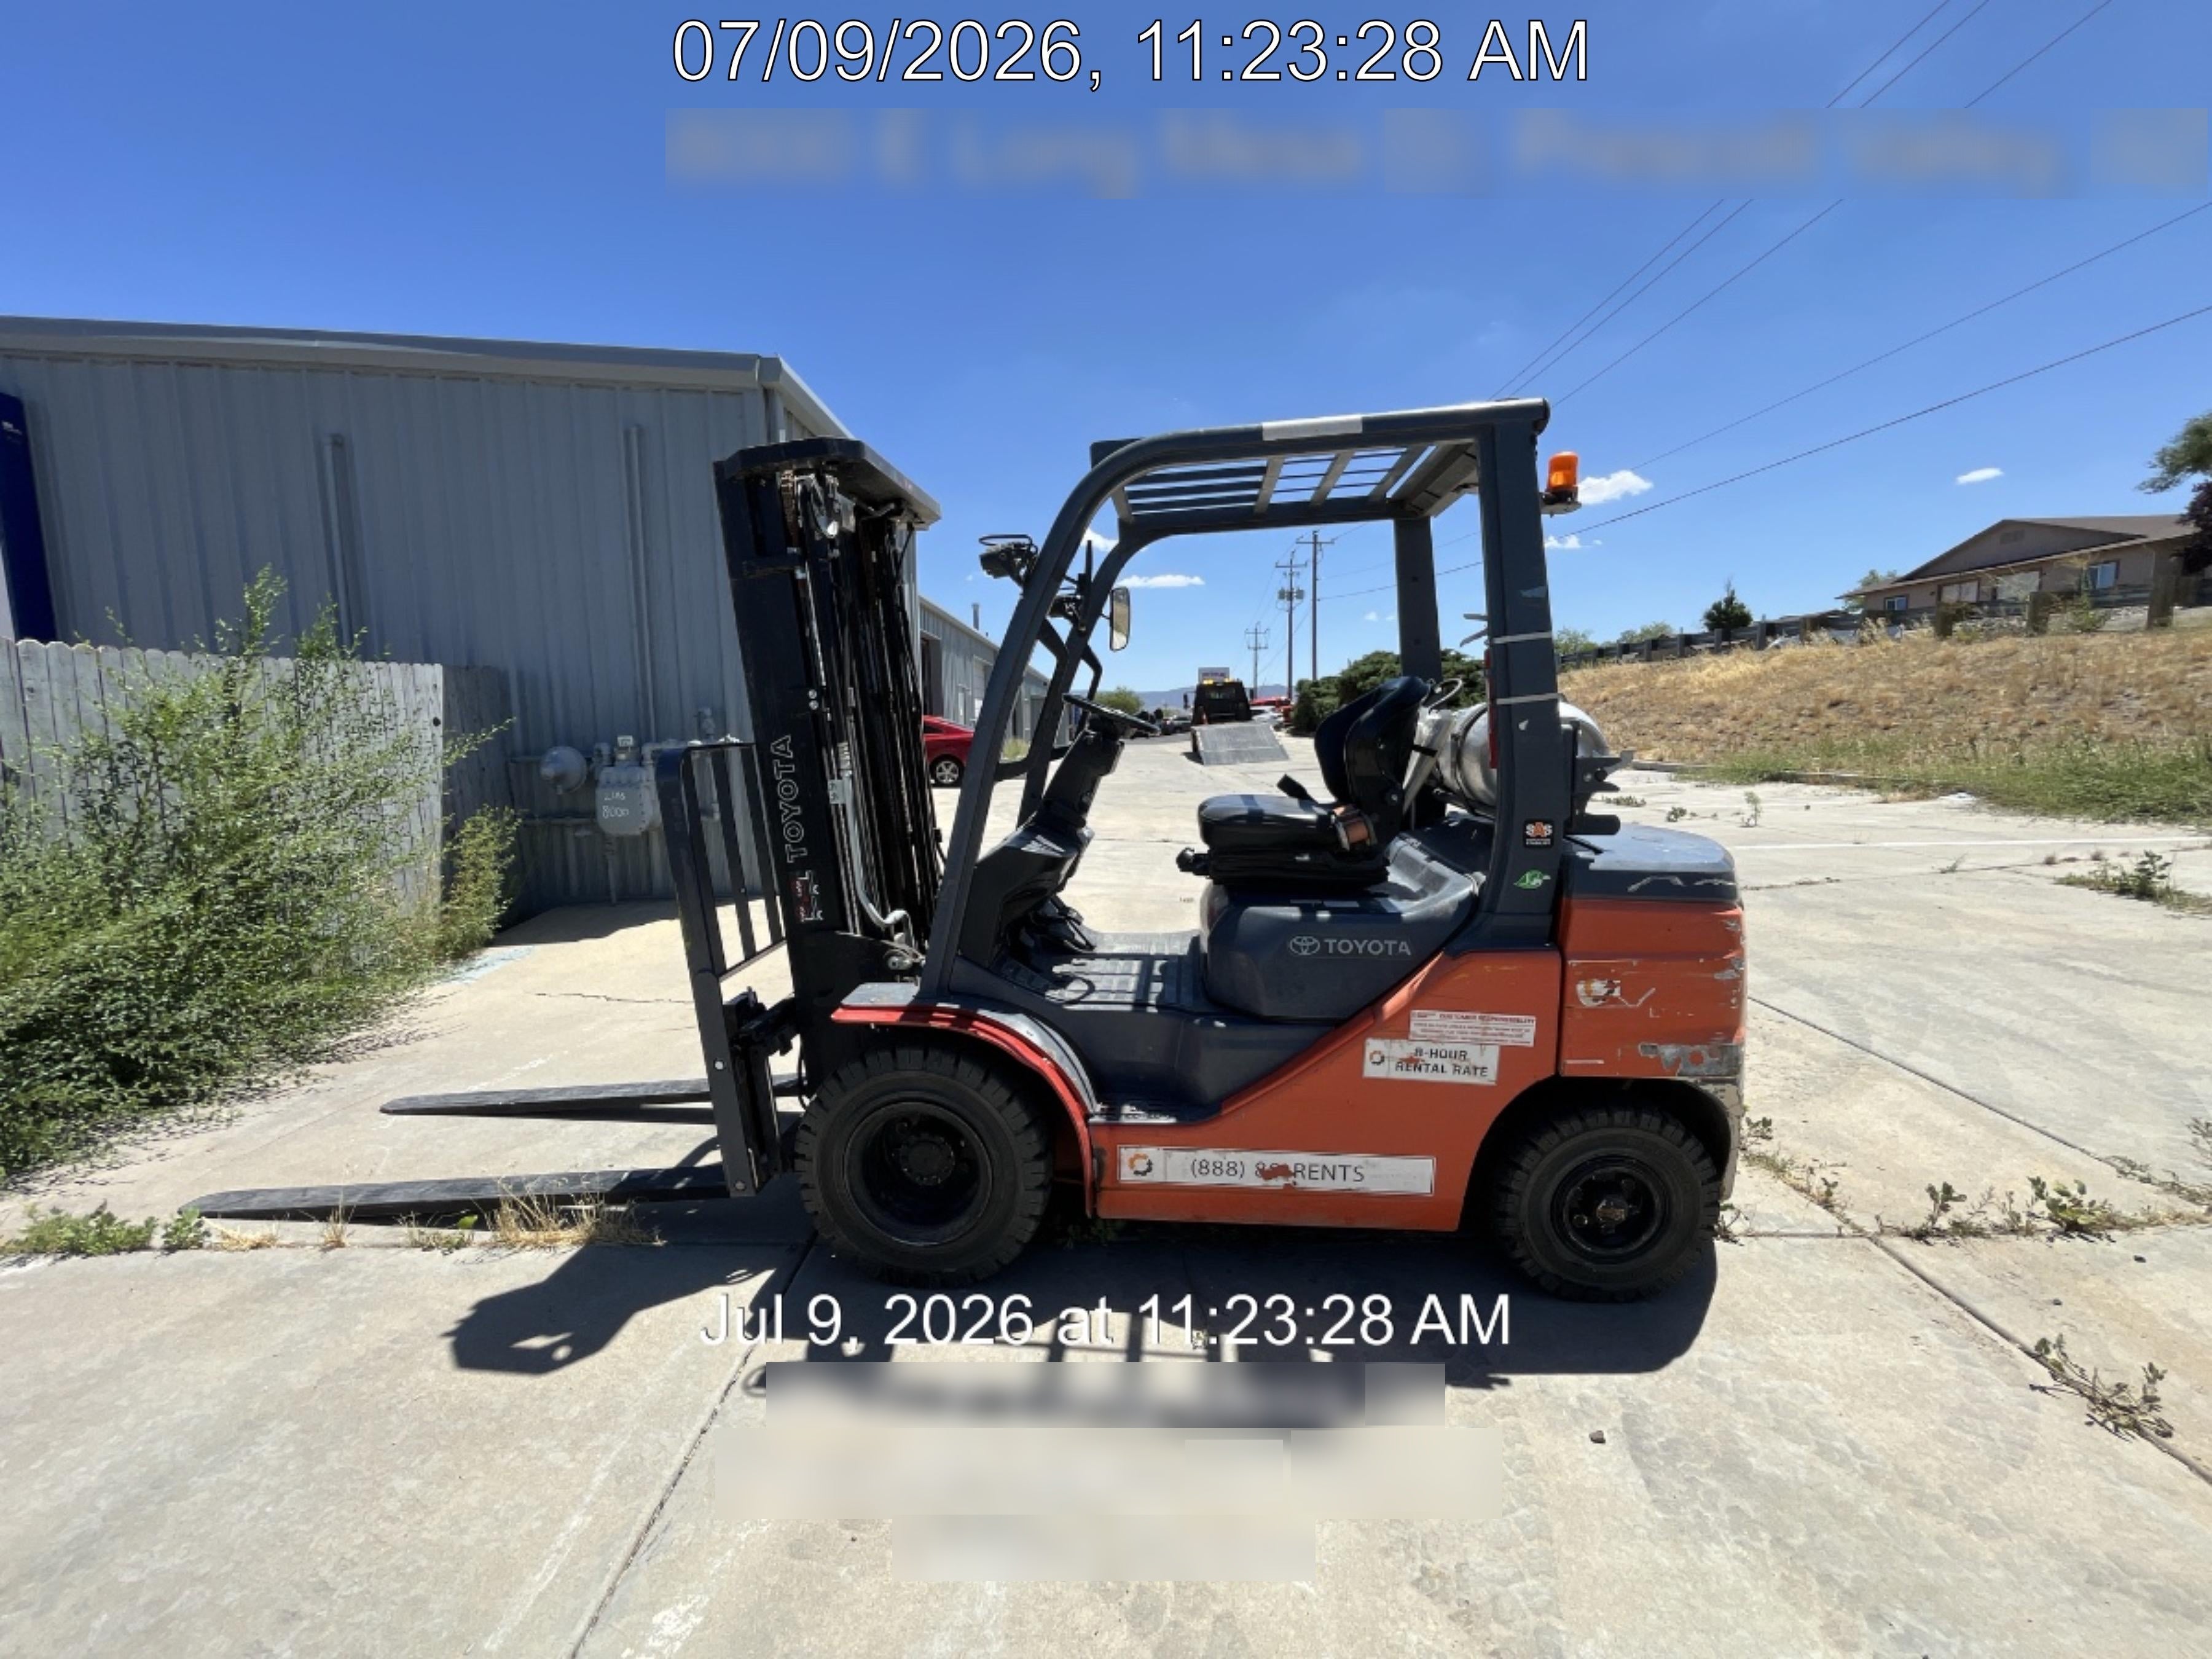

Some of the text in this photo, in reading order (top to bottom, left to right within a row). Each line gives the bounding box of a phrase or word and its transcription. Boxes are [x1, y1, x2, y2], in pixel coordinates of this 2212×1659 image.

[771, 735, 807, 863] TOYOTA
[1324, 939, 1411, 955] TOYOTA
[1395, 1061, 1489, 1077] RENTAL RATE
[1191, 1159, 1245, 1180] (888)
